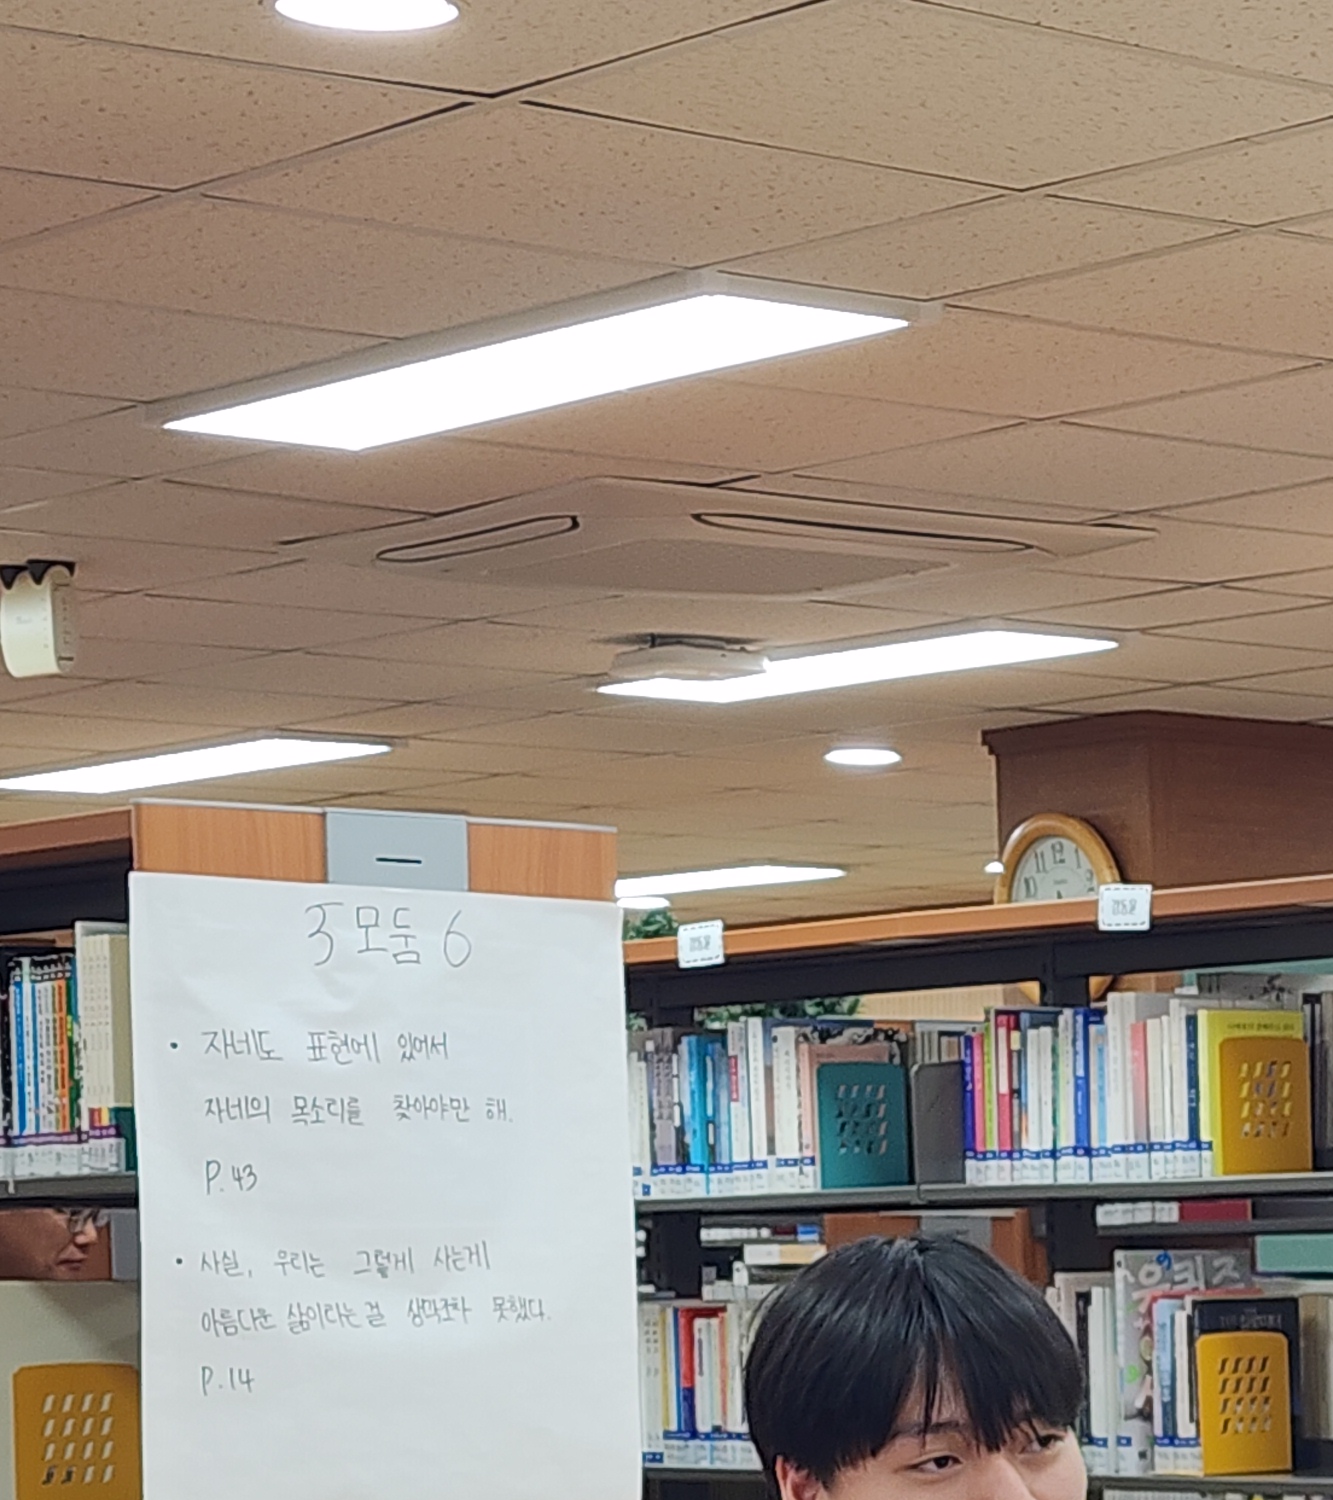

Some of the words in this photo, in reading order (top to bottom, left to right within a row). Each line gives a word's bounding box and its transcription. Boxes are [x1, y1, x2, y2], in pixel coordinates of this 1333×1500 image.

[444, 909, 472, 968] 6
[201, 1029, 283, 1062] 자네도
[306, 1030, 380, 1066] 표현에
[397, 1031, 449, 1062] 있어서
[204, 1095, 271, 1124] 자네의
[291, 1096, 365, 1127] 목소리를
[393, 1094, 471, 1123] 찾아야만
[485, 1097, 513, 1124] 해.
[200, 1250, 252, 1279] 사실,
[274, 1250, 326, 1278] 우리는
[201, 1308, 277, 1338] 아름다운
[492, 1294, 551, 1324] 못했다.
